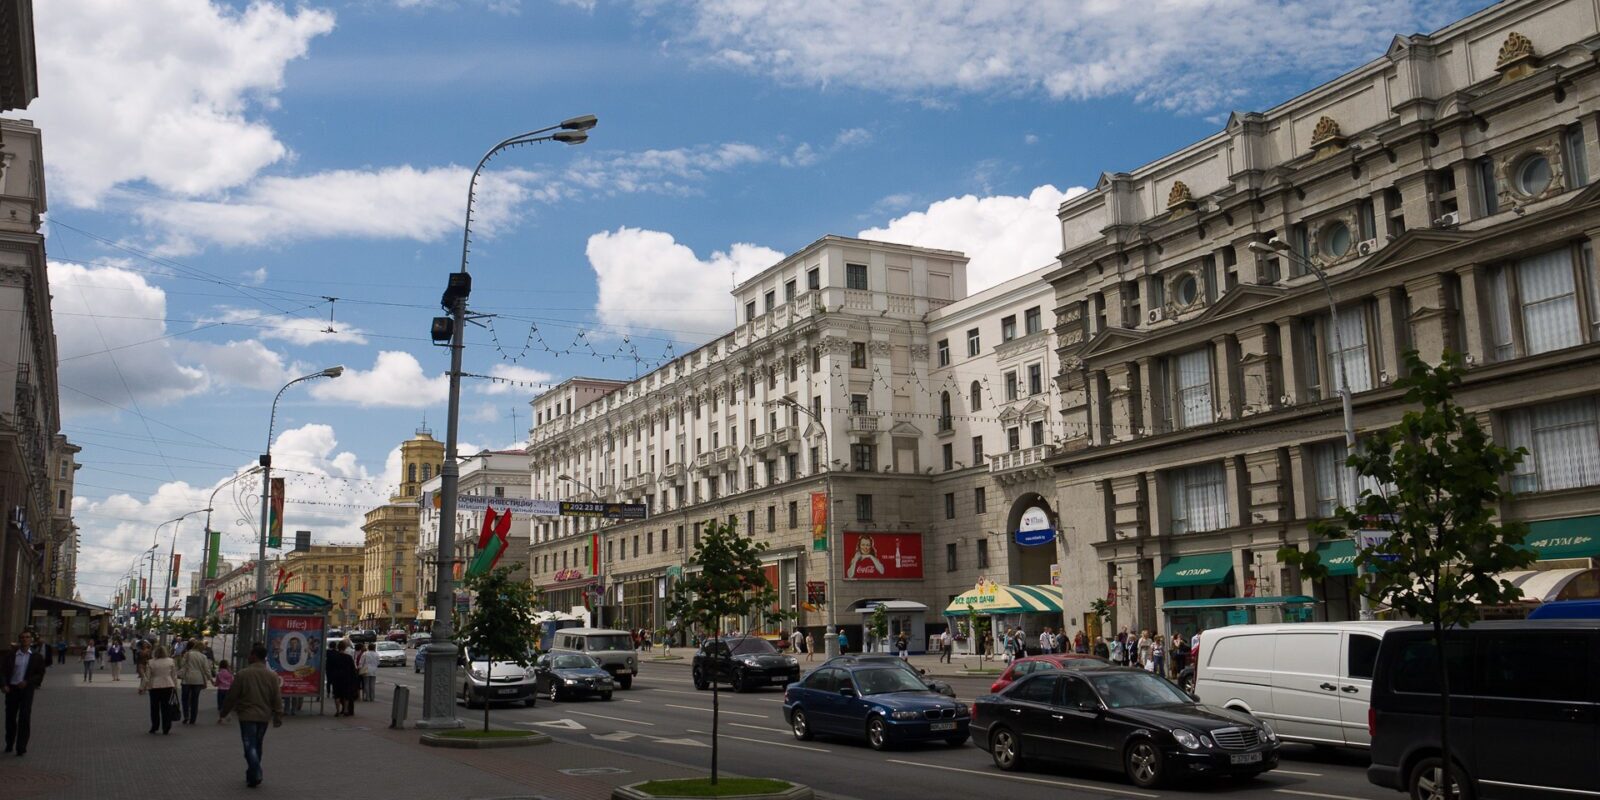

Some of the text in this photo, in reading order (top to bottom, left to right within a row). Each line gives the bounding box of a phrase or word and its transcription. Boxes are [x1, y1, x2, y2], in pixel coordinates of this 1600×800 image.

[458, 496, 533, 508] СОЧНЫЕ ИНВЕСТИЦИИ
[570, 503, 584, 511] 202
[1549, 537, 1573, 546] ГУМ
[1186, 568, 1202, 576] ГУМ
[955, 595, 995, 605] ВСЕ ДЛЯ ДАЧИ
